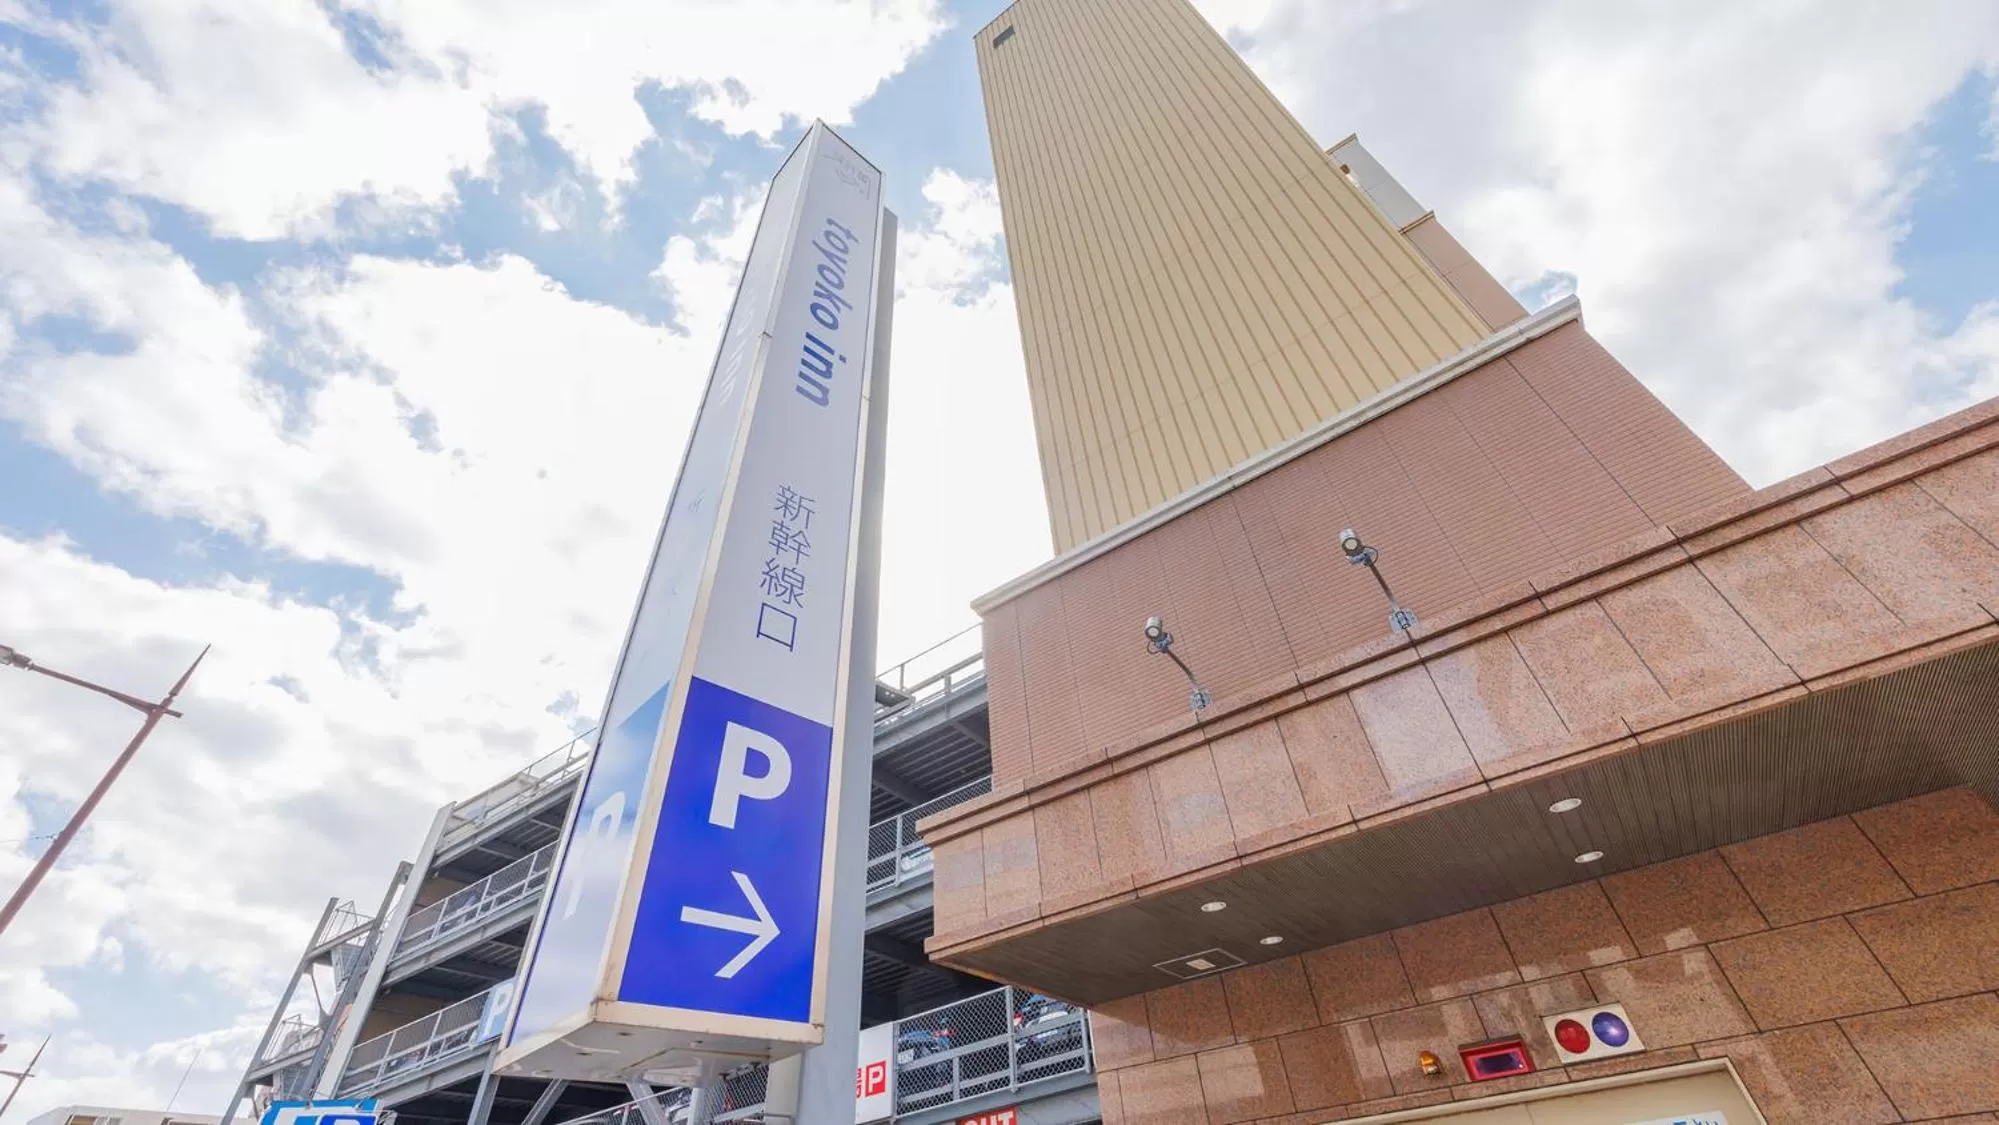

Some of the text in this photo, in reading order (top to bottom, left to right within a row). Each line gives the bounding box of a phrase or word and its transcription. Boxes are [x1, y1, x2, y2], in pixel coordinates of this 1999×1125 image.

[795, 217, 859, 407] toyoko inn
[756, 484, 815, 652] 新幹線口
[708, 721, 792, 830] P
[868, 1066, 884, 1093] P
